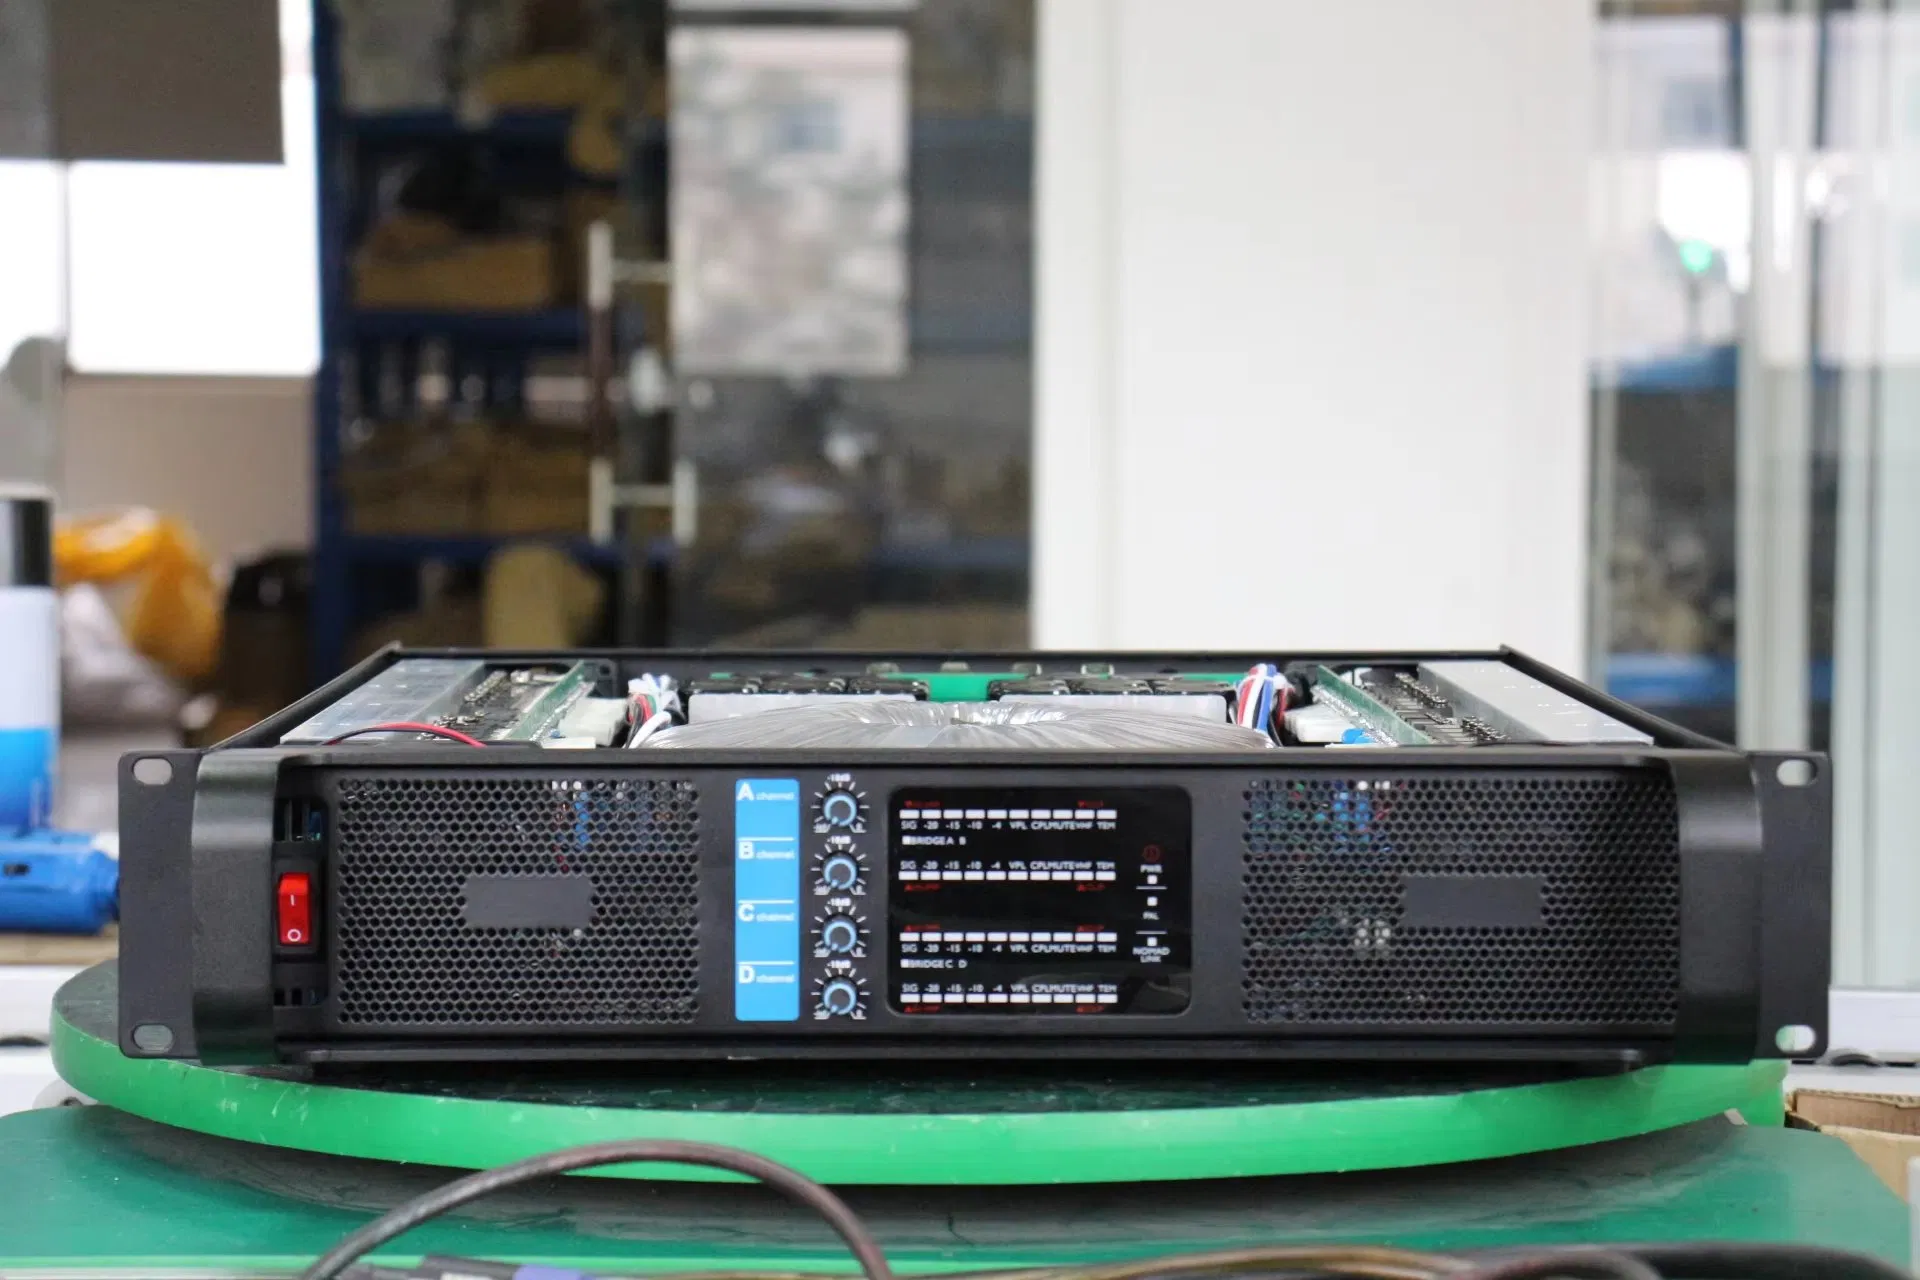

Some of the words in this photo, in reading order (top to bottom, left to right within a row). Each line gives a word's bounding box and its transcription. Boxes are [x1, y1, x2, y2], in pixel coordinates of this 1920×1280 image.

[737, 782, 754, 801] A
[756, 792, 794, 801] channel
[901, 821, 917, 830] SIG
[923, 821, 938, 830] -20
[945, 821, 960, 830] -15
[968, 821, 982, 830] -10
[992, 821, 1002, 830] -4
[738, 841, 754, 860] B
[756, 851, 794, 860] channel
[900, 861, 916, 870] SIG
[922, 861, 937, 870] -20
[944, 861, 959, 870] -15
[967, 861, 981, 870] -10
[991, 861, 1001, 870] -4
[738, 903, 755, 922] C
[756, 913, 794, 922] channel
[901, 944, 917, 953] SIG
[923, 944, 938, 953] -20
[945, 944, 960, 953] -15
[968, 944, 982, 953] -10
[992, 944, 1002, 953] -4
[945, 959, 953, 969] C
[958, 959, 967, 969] D
[738, 965, 755, 984] D
[756, 975, 794, 984] channel
[902, 984, 918, 993] SIG
[924, 984, 939, 993] -20
[946, 984, 961, 993] -15
[969, 984, 983, 993] -10
[993, 984, 1003, 993] -4
